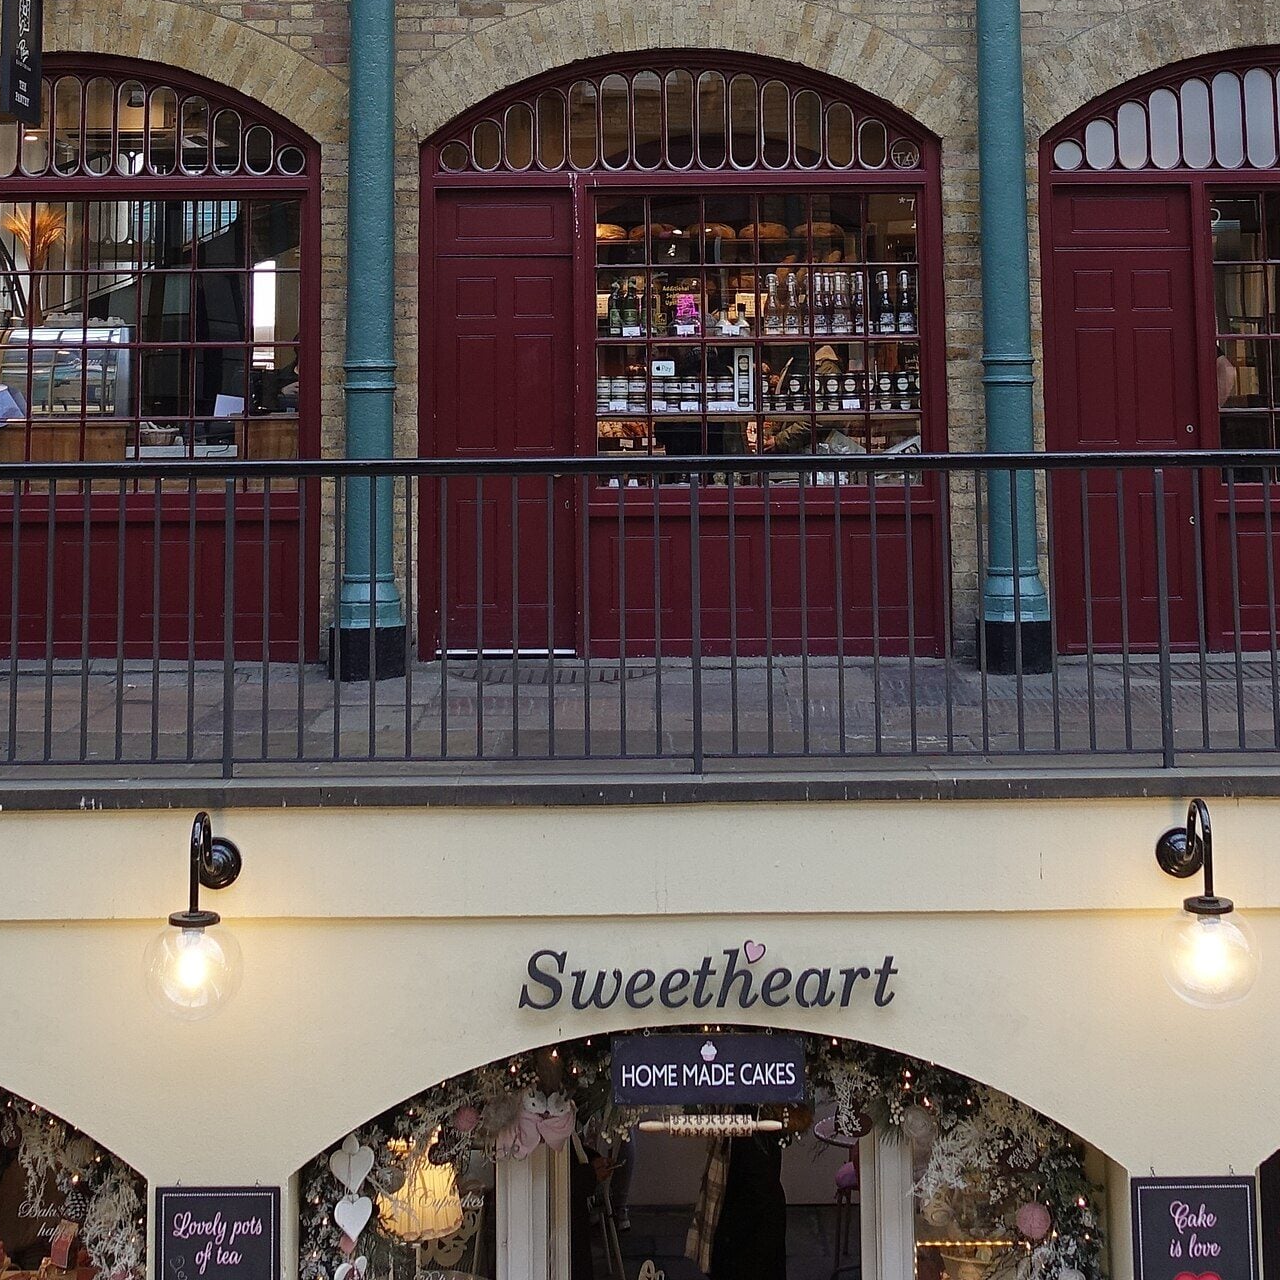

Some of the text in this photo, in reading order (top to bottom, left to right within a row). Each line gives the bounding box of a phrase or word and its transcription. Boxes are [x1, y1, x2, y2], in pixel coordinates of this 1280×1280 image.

[518, 948, 899, 1010] Sweetheart
[621, 1062, 796, 1087] HOME MADE CAKES
[172, 1211, 263, 1246] Lovely pots
[1169, 1200, 1218, 1235] Cake
[195, 1241, 244, 1275] of tea
[1169, 1233, 1222, 1258] is love
